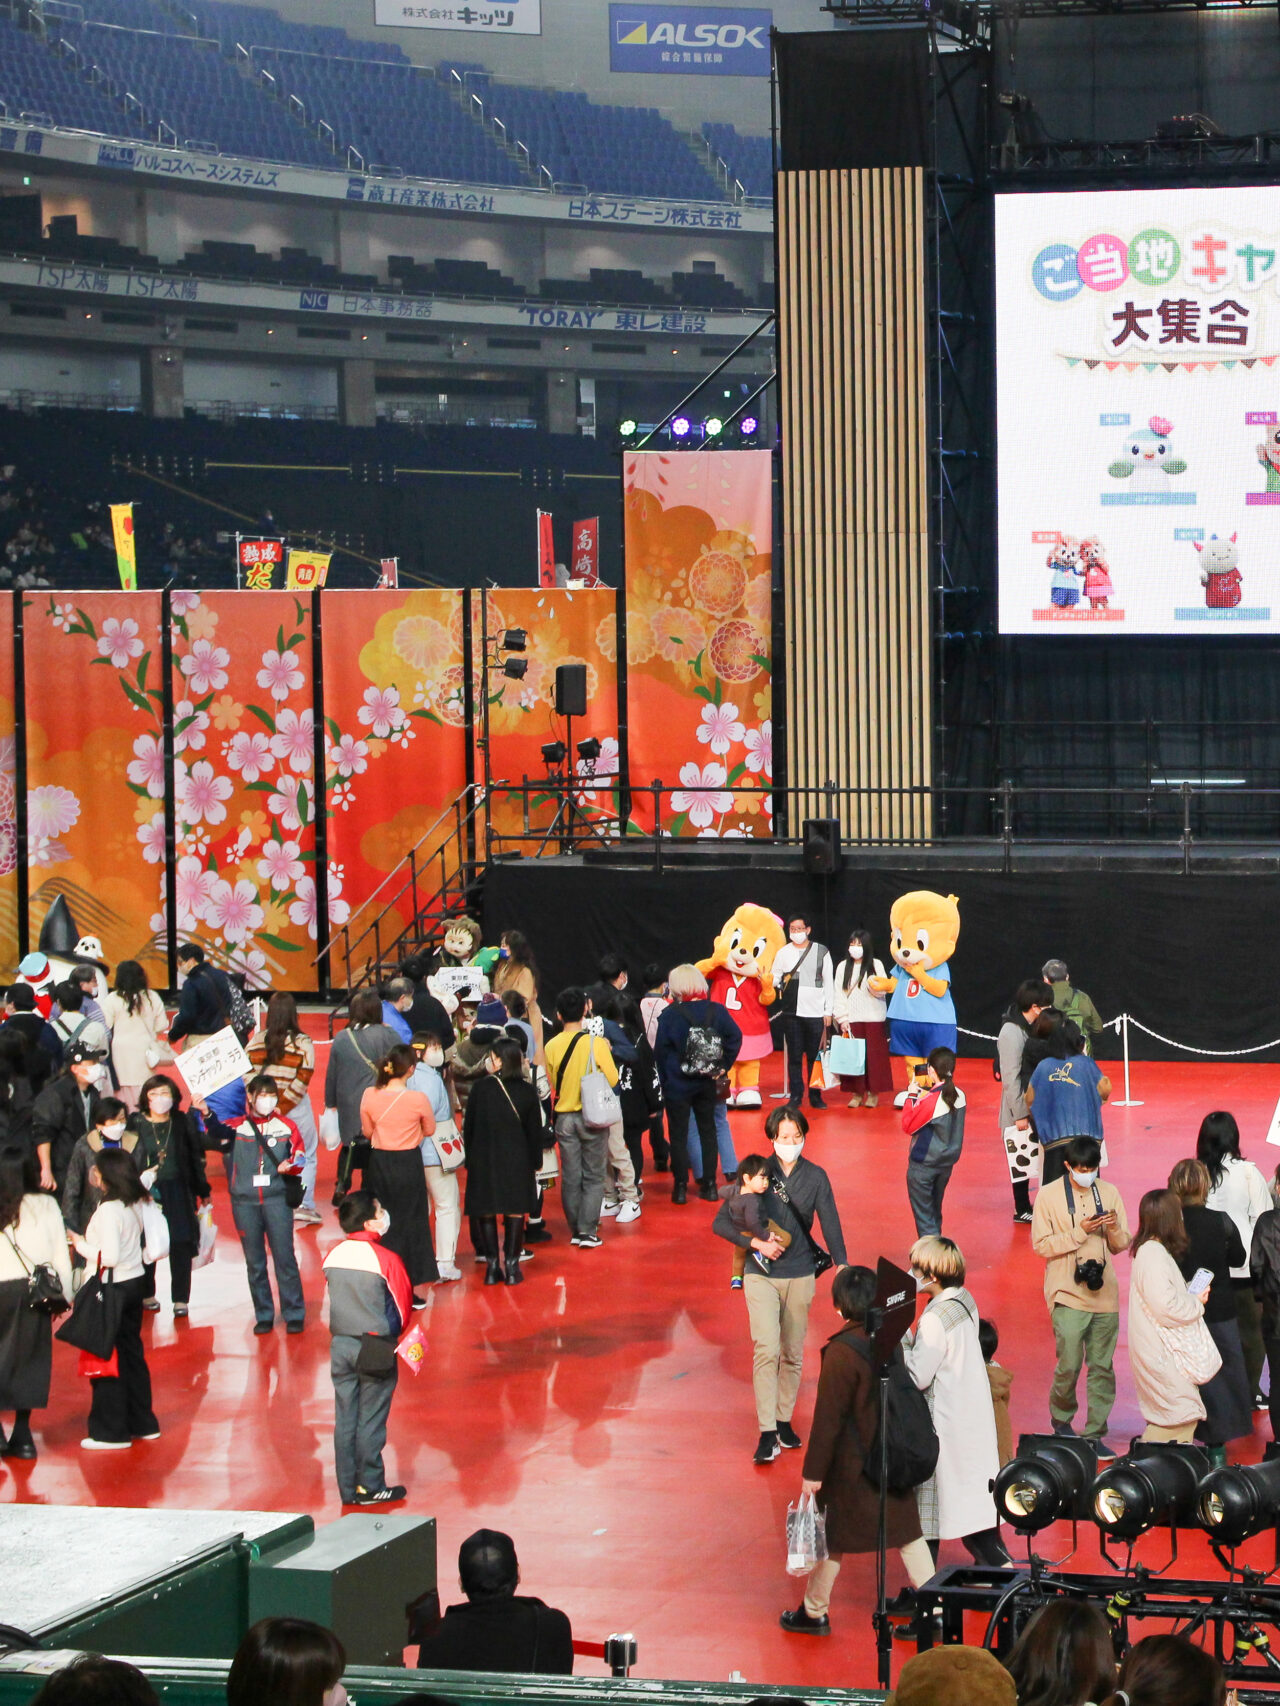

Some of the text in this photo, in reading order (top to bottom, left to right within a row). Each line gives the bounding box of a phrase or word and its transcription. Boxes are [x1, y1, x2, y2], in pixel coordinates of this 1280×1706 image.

[402, 7, 514, 26] 株式会社キッツ
[649, 23, 765, 48] ALSOK
[367, 184, 496, 212] 蔵王産業株式会社
[568, 200, 743, 229] 日本ステージ株式会社
[302, 291, 328, 307] NJC
[615, 312, 706, 333] 東レ建設
[1112, 298, 1250, 347] 大集合
[725, 987, 742, 1010] L
[906, 978, 920, 998] D
